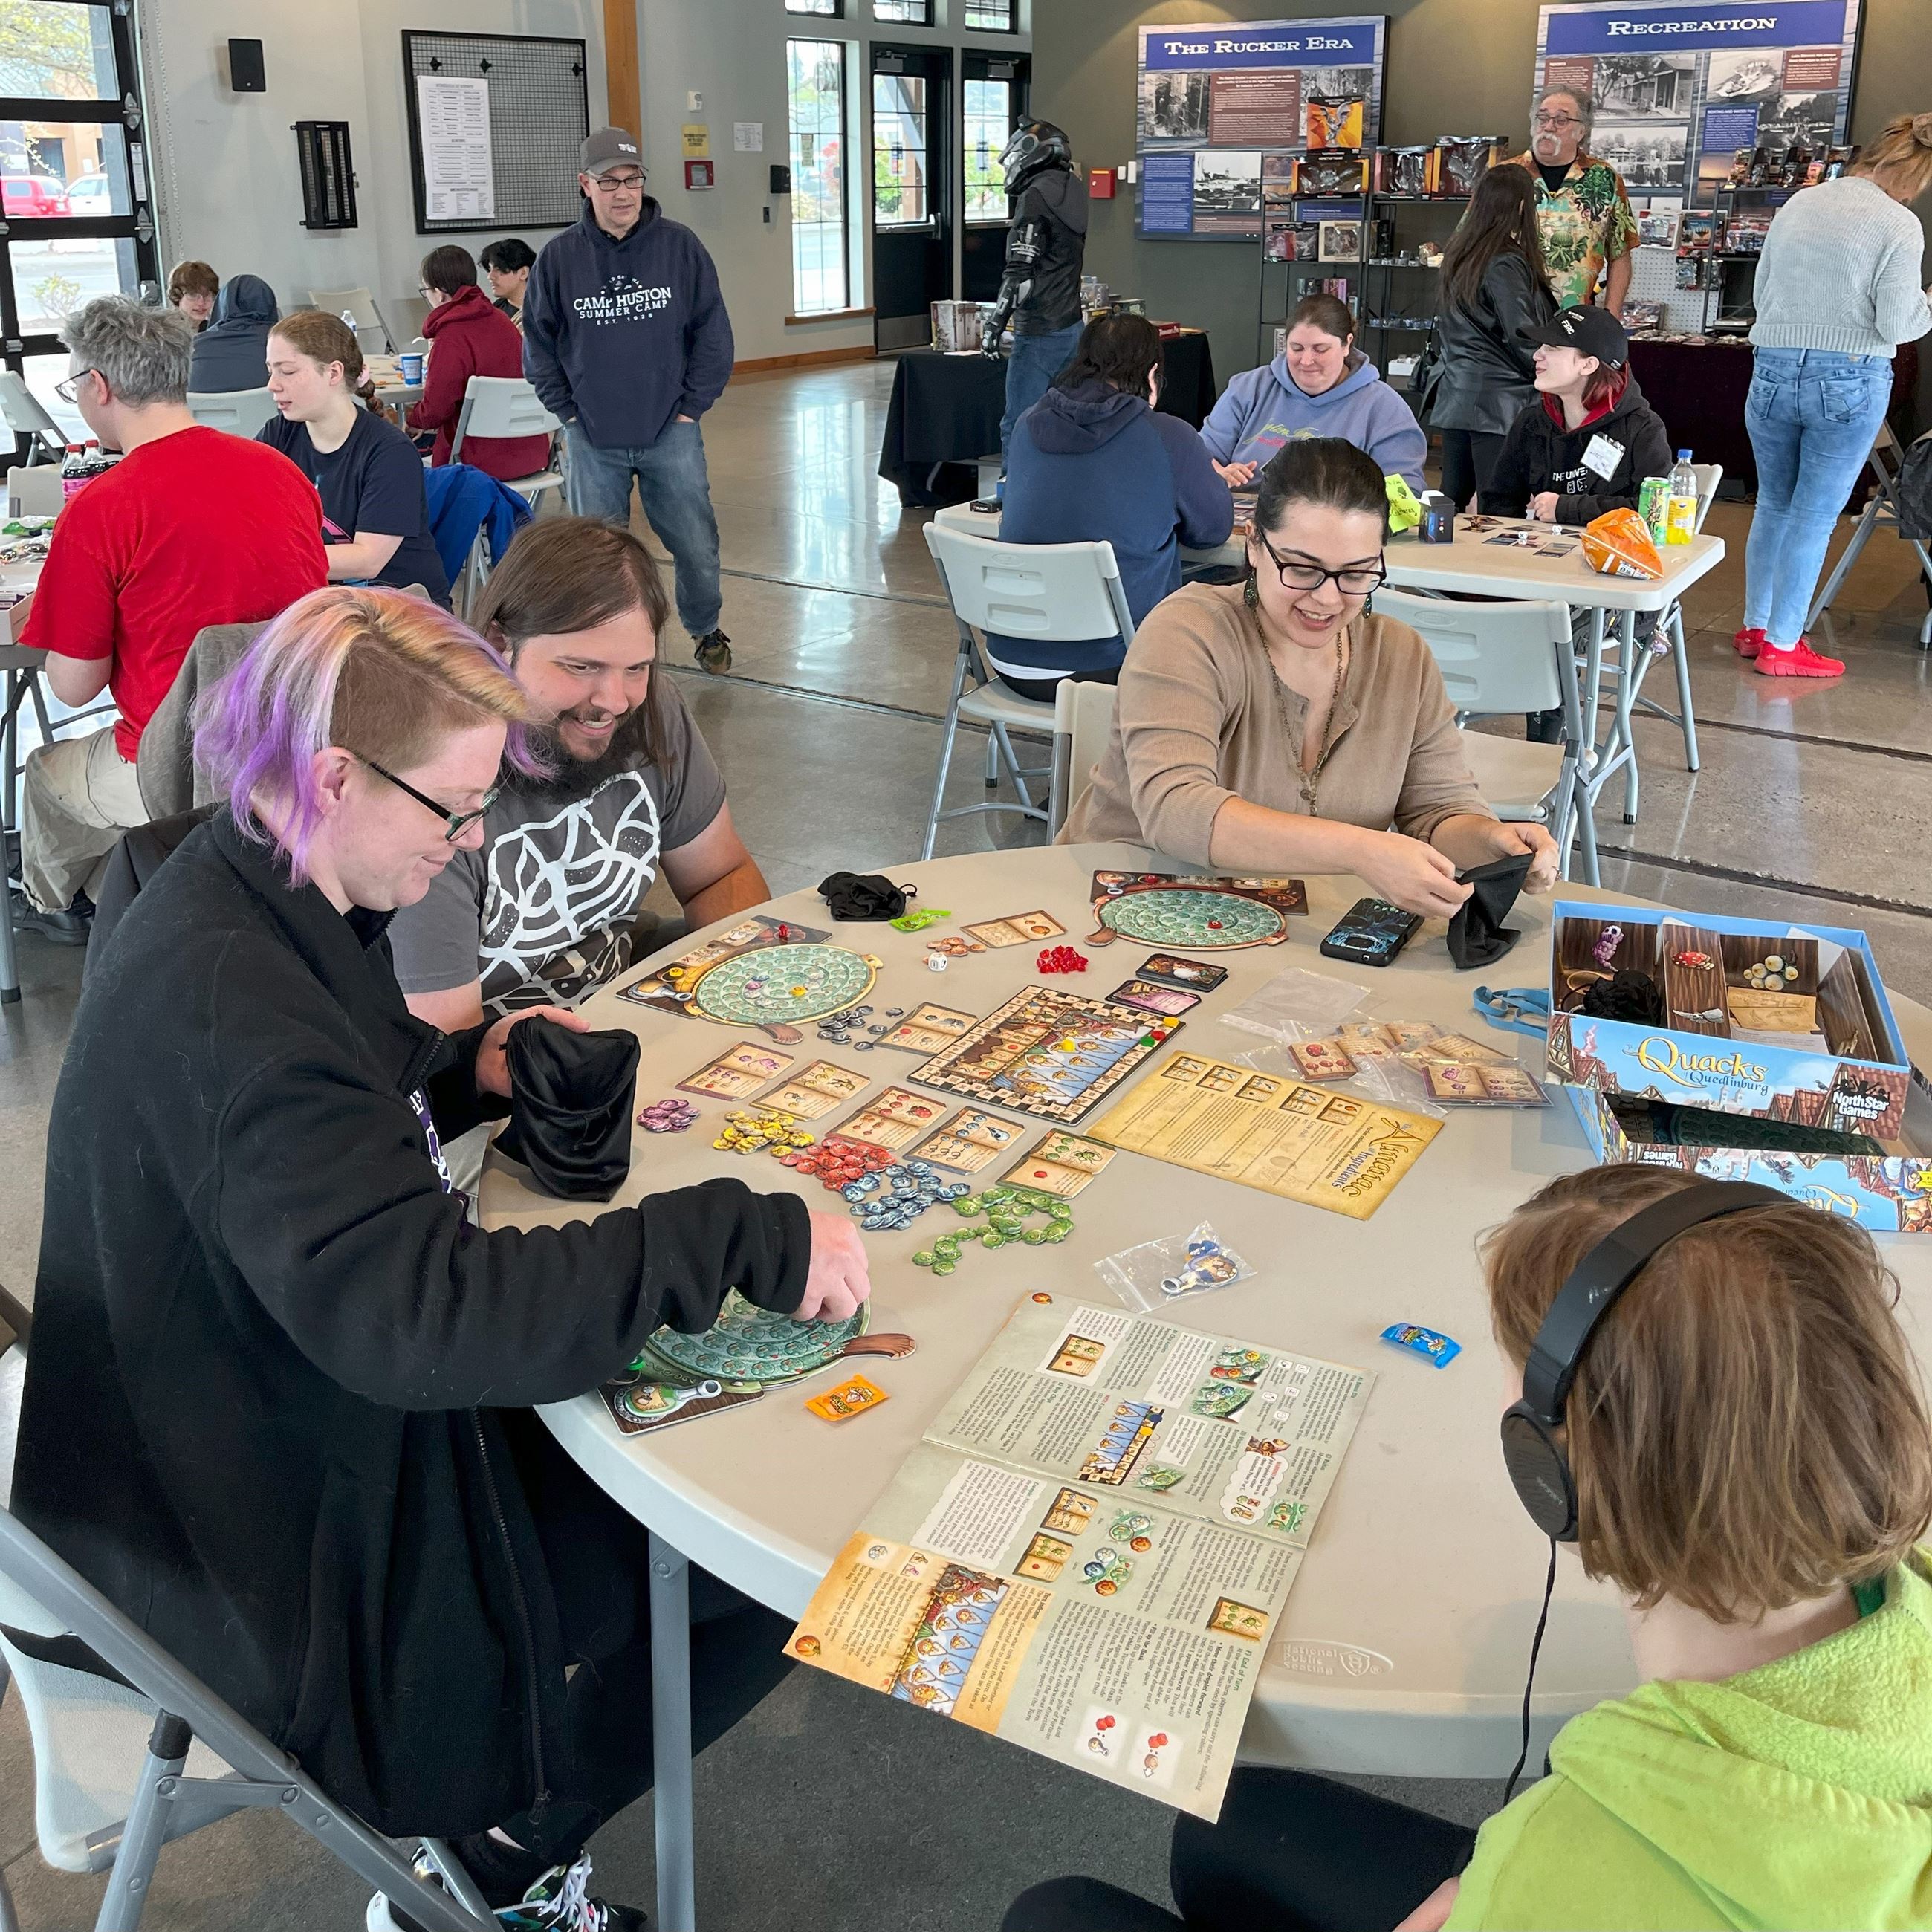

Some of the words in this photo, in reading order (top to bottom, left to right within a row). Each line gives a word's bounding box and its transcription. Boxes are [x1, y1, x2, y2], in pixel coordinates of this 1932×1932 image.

[1607, 17, 1778, 36] RECREATION
[1164, 42, 1209, 56] THE
[1213, 39, 1300, 55] RUCKER
[1306, 36, 1354, 51] ERA
[574, 296, 613, 311] CAMP
[616, 287, 672, 307] HUSTON
[580, 307, 630, 319] SUMMER
[635, 299, 667, 312] CAMP
[1622, 1036, 1769, 1088] Quacks
[1690, 1070, 1769, 1096] Quedlinburg
[1832, 1092, 1864, 1107] North
[1864, 1095, 1890, 1112] Star
[1838, 1103, 1878, 1120] Games
[1341, 1117, 1426, 1198] Almanac
[1643, 1151, 1677, 1161] Games
[1331, 1150, 1375, 1188] Ingredients
[1083, 1641, 1094, 1655] takes
[1112, 1644, 1122, 1659] again
[1142, 1640, 1150, 1649] the
[1212, 1645, 1221, 1658] Move
[1283, 1644, 1338, 1658] National
[1080, 1654, 1089, 1664] his
[1105, 1647, 1113, 1657] The
[1119, 1652, 1129, 1664] Turn
[1138, 1648, 1147, 1662] flask
[1283, 1653, 1323, 1665] Public
[1100, 1657, 1109, 1670] flask
[1106, 1659, 1117, 1675] shows
[1125, 1657, 1135, 1671] their
[1146, 1653, 1157, 1670] higher
[1182, 1653, 1192, 1667] space
[1208, 1658, 1217, 1671] their
[1239, 1656, 1249, 1668] End
[1115, 1664, 1123, 1677] over
[1153, 1667, 1161, 1679] they
[1167, 1661, 1181, 1687] advantage
[1237, 1669, 1245, 1677] of
[1283, 1662, 1334, 1676] Seating
[1072, 1673, 1082, 1688] stone
[1111, 1677, 1119, 1688] the
[1119, 1671, 1129, 1688] flasks
[1158, 1670, 1169, 1685] being
[1186, 1675, 1194, 1685] and
[1201, 1671, 1213, 1692] droplet
[1226, 1674, 1234, 1684] the
[1233, 1676, 1243, 1692] Turn
[1068, 1688, 1076, 1698] out
[1091, 1681, 1100, 1695] then
[1098, 1685, 1107, 1697] side
[1149, 1679, 1158, 1693] draw
[1155, 1686, 1164, 1698] able
[1181, 1685, 1190, 1700] move
[1059, 1689, 1068, 1699] the
[1106, 1687, 1116, 1702] flask
[1113, 1695, 1121, 1705] the
[1145, 1692, 1153, 1702] out
[1170, 1692, 1180, 1705] This
[1187, 1688, 1199, 1707] players
[1054, 1699, 1064, 1711] pile
[1062, 1705, 1071, 1716] the
[1177, 1700, 1186, 1715] their
[1194, 1692, 1207, 1715] forward
[1208, 1702, 1217, 1710] by
[1215, 1696, 1228, 1717] players
[1167, 1705, 1176, 1717] will
[1057, 1715, 1066, 1725] pot
[1213, 1717, 1221, 1727] can
[1044, 1717, 1057, 1740] Fortune
[1054, 1726, 1063, 1738] and
[1208, 1726, 1217, 1743] carry
[1202, 1754, 1210, 1765] the
[1194, 1764, 1208, 1792] following
